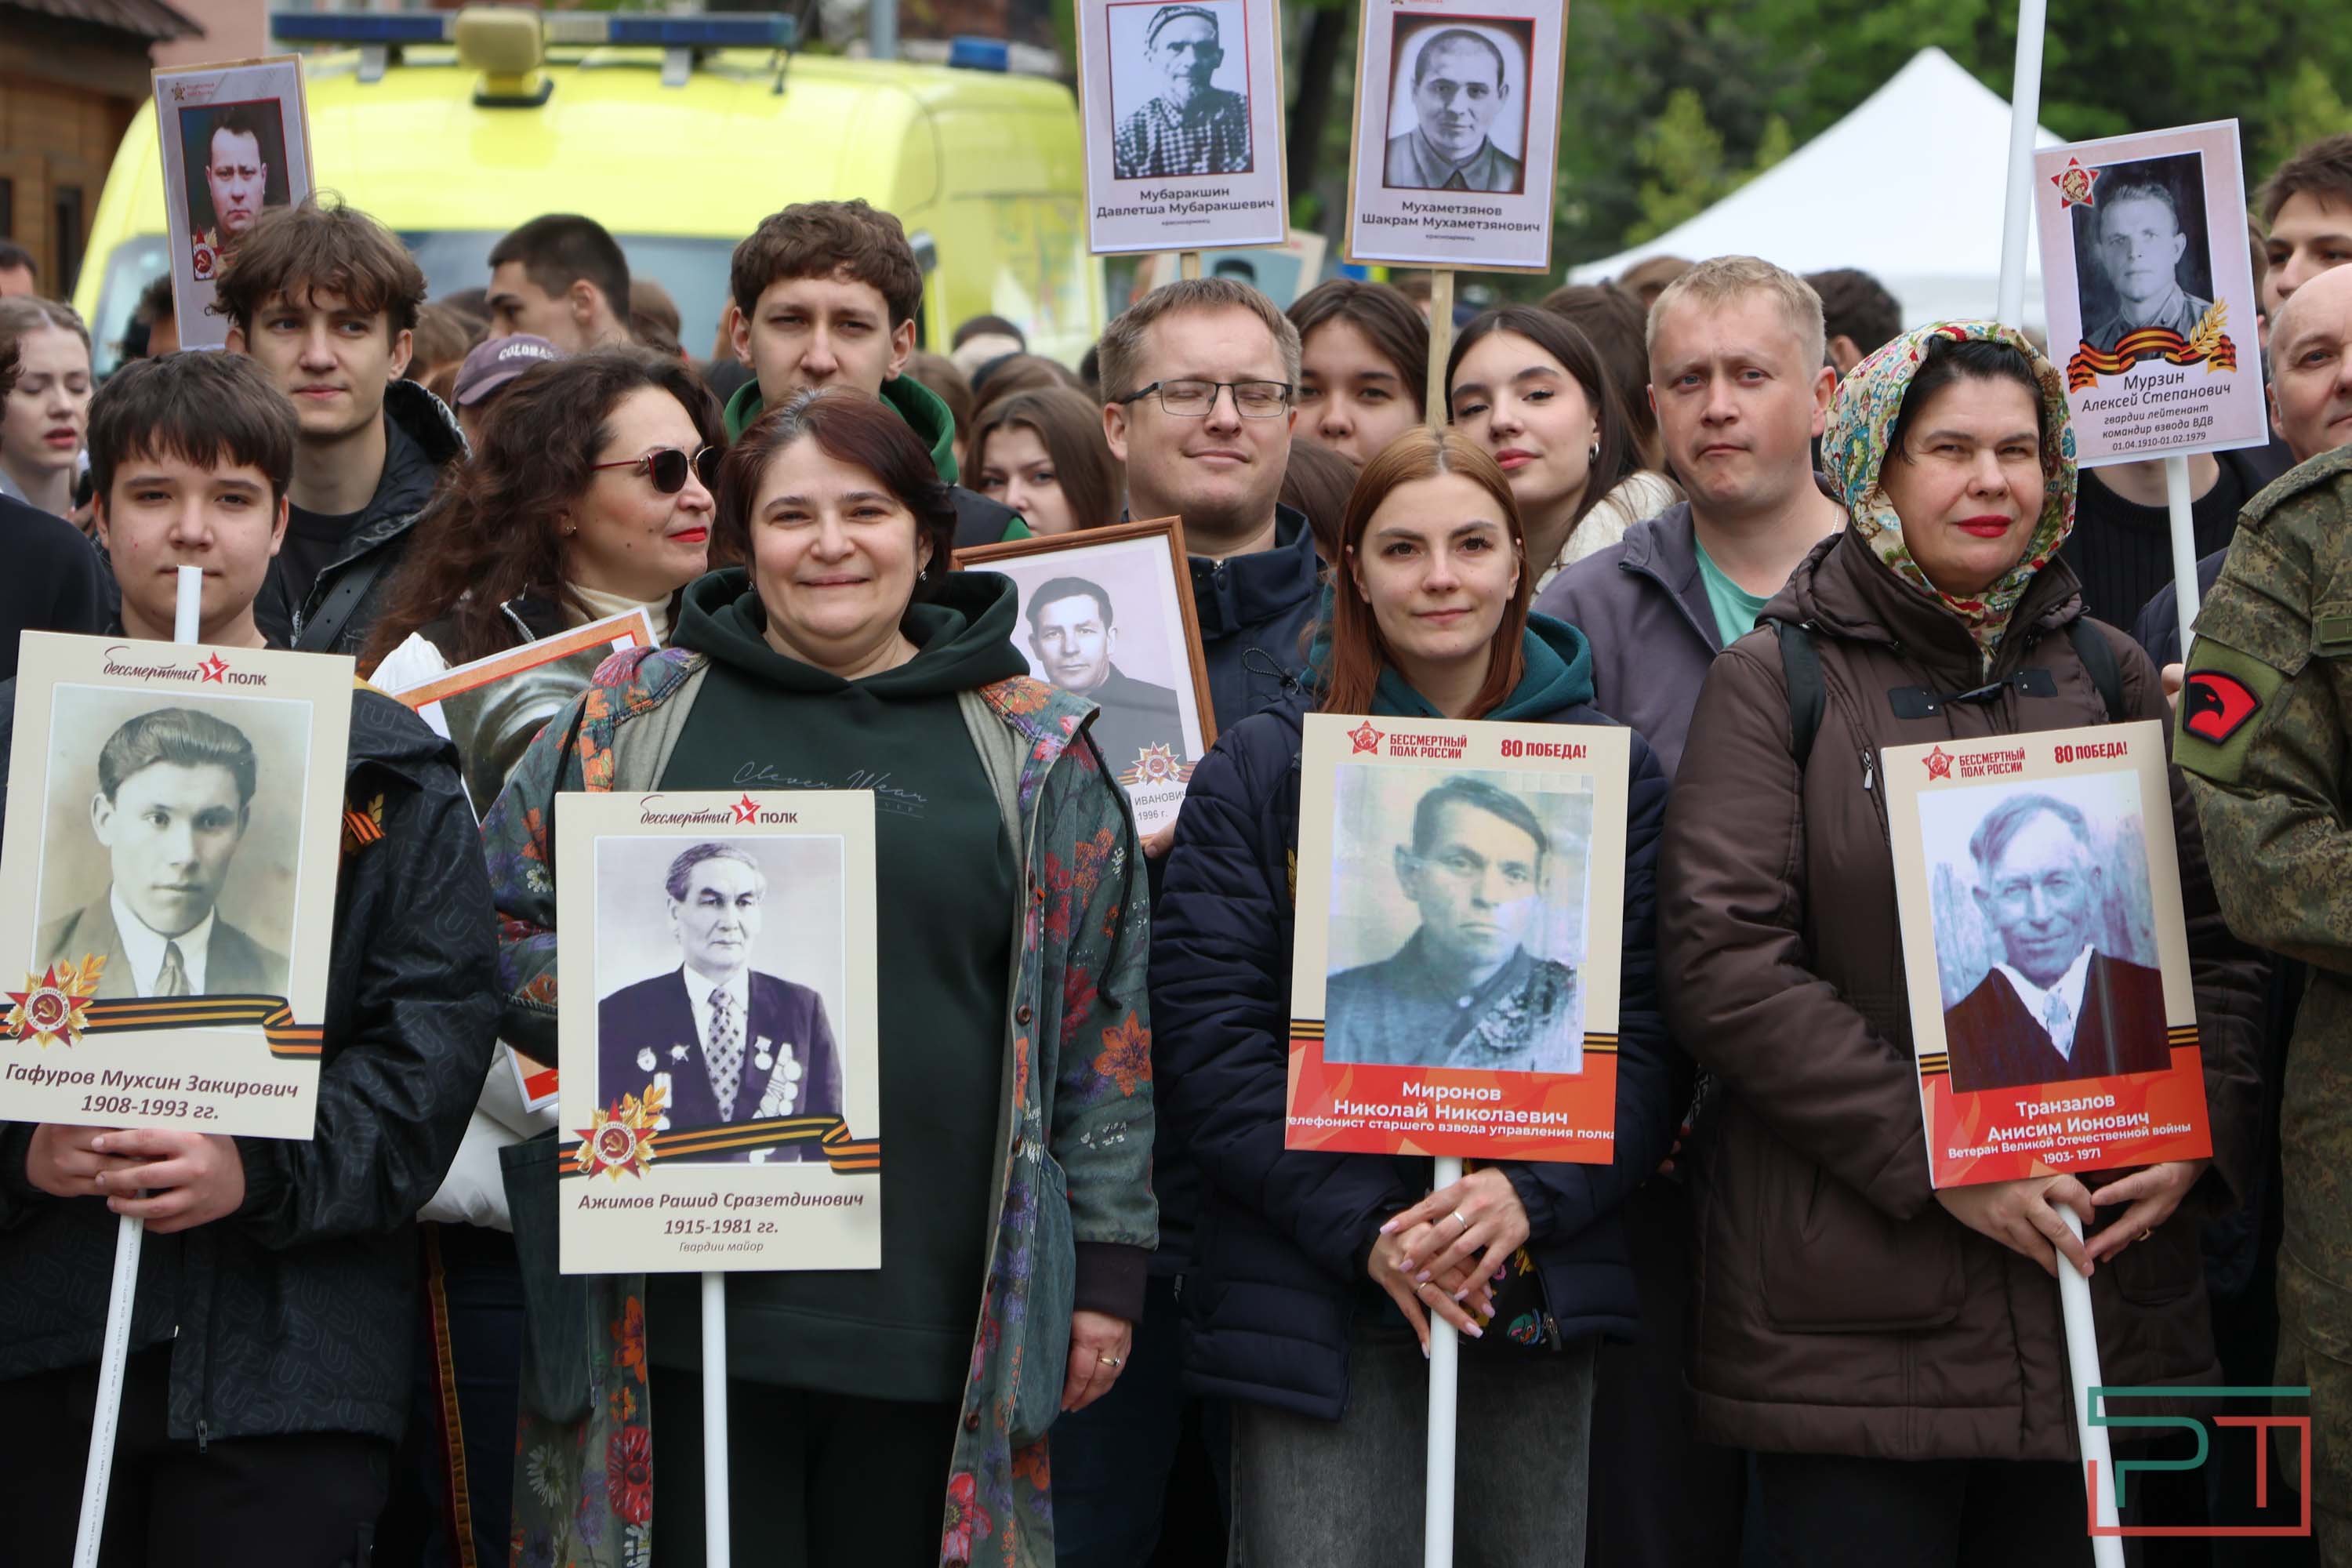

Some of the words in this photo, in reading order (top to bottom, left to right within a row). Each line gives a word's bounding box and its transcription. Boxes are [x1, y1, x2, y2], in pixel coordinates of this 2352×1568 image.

[1140, 187, 1230, 202] Мубаракшин
[1097, 205, 1165, 219] Давлетша
[1170, 200, 1274, 215] Мубаракшевич
[1402, 201, 1503, 216] Мухаметзянов
[1362, 213, 1418, 227] Шакрам
[1423, 216, 1540, 232] Мухаметзянович
[2124, 372, 2185, 390] Мурзин
[2082, 391, 2138, 412] Алексей
[2143, 383, 2231, 405] Степанович
[2104, 412, 2145, 425] гвардии
[2147, 404, 2209, 419] лейтенант
[2103, 424, 2152, 439] командир
[2154, 419, 2190, 432] взвода
[2193, 416, 2213, 427] ВДВ
[2112, 432, 2206, 451] 01.04.1910-01.02.1979
[103, 645, 200, 682] бессмертный
[1390, 734, 1468, 748] БЕССМЕРТНЫЙ
[1501, 739, 1523, 757] 80
[1526, 742, 1587, 760] ПОБЕДА!
[1390, 746, 1418, 757] ПОЛК
[1421, 747, 1462, 759] РОССИИ
[1959, 747, 2026, 767] БЕССМЕРТНЫЙ
[2054, 745, 2074, 764] 80
[2075, 741, 2128, 759] ПОБЕДА!
[1961, 765, 1986, 778] ПОЛК
[1987, 761, 2023, 775] РОССИИ
[640, 794, 732, 829] бессмертный
[5, 1063, 95, 1087] Гафуров
[100, 1069, 181, 1091] Мухсин
[186, 1075, 299, 1098] Закирович
[1402, 1081, 1501, 1102] Миронов
[82, 1094, 188, 1117] 1908-1993
[193, 1105, 219, 1120] гг.
[1334, 1099, 1428, 1118] Николай
[1436, 1104, 1568, 1125] Николаевич
[2016, 1094, 2115, 1120] Транзалов
[1369, 1119, 1435, 1132] старшего
[1438, 1123, 1486, 1134] взвода
[1489, 1124, 1573, 1138] управления
[1987, 1122, 2062, 1142] Анисим
[2067, 1112, 2150, 1133] Ионович
[1948, 1145, 1998, 1159] Ветеран
[2002, 1136, 2054, 1152] Великой
[2057, 1127, 2149, 1146] Отечественной
[2152, 1123, 2191, 1135] войны
[2077, 1148, 2101, 1160] 1971
[578, 1194, 654, 1210] Ажимов
[659, 1192, 718, 1208] Рашид
[724, 1192, 864, 1210] Сразетдинович
[664, 1219, 751, 1235] 1915-1981
[757, 1221, 779, 1234] гг.
[679, 1241, 724, 1254] Гвардии
[727, 1240, 764, 1253] майор
